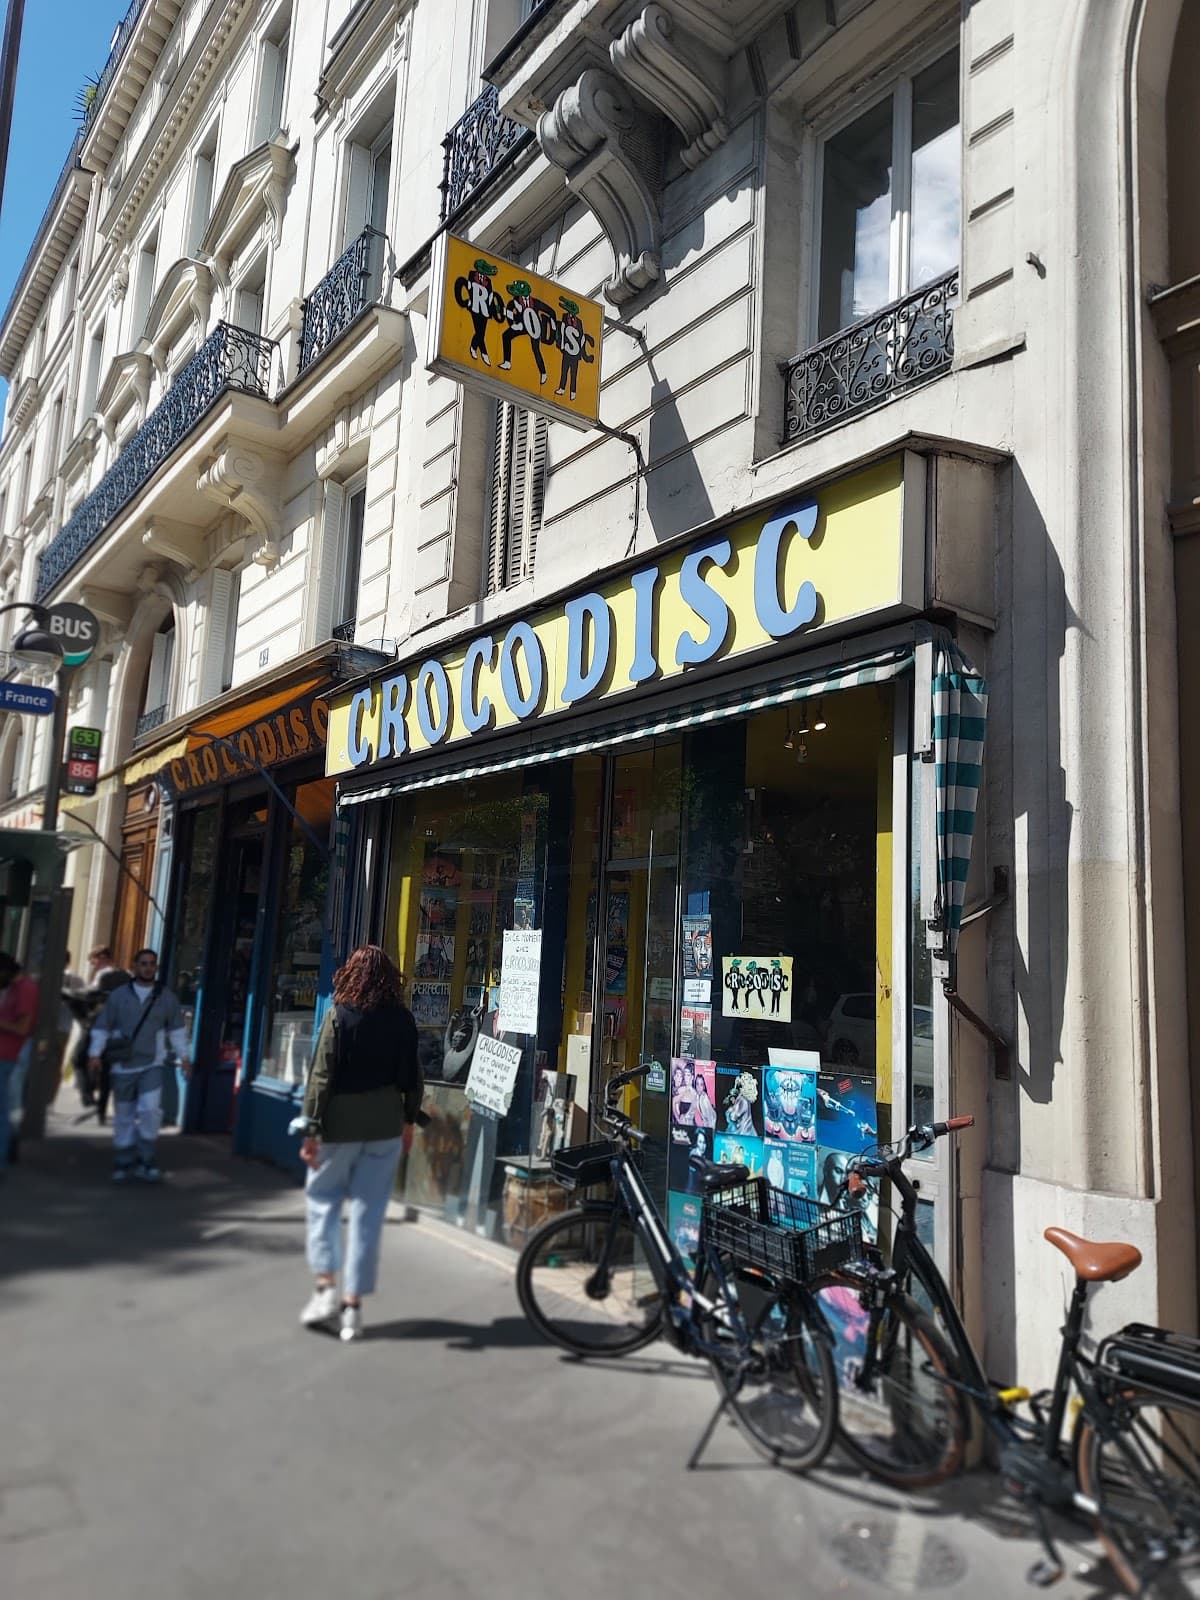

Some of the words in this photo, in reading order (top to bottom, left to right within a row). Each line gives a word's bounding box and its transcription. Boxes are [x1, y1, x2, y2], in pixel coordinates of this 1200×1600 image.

[50, 615, 92, 640] BUS
[347, 500, 819, 768] CROCODISC
[5, 690, 48, 707] France
[75, 731, 95, 745] 63
[171, 699, 329, 792] CROCODISC
[71, 763, 93, 778] 86
[725, 972, 788, 992] CROCODISC
[479, 1037, 520, 1065] CROCODISC
